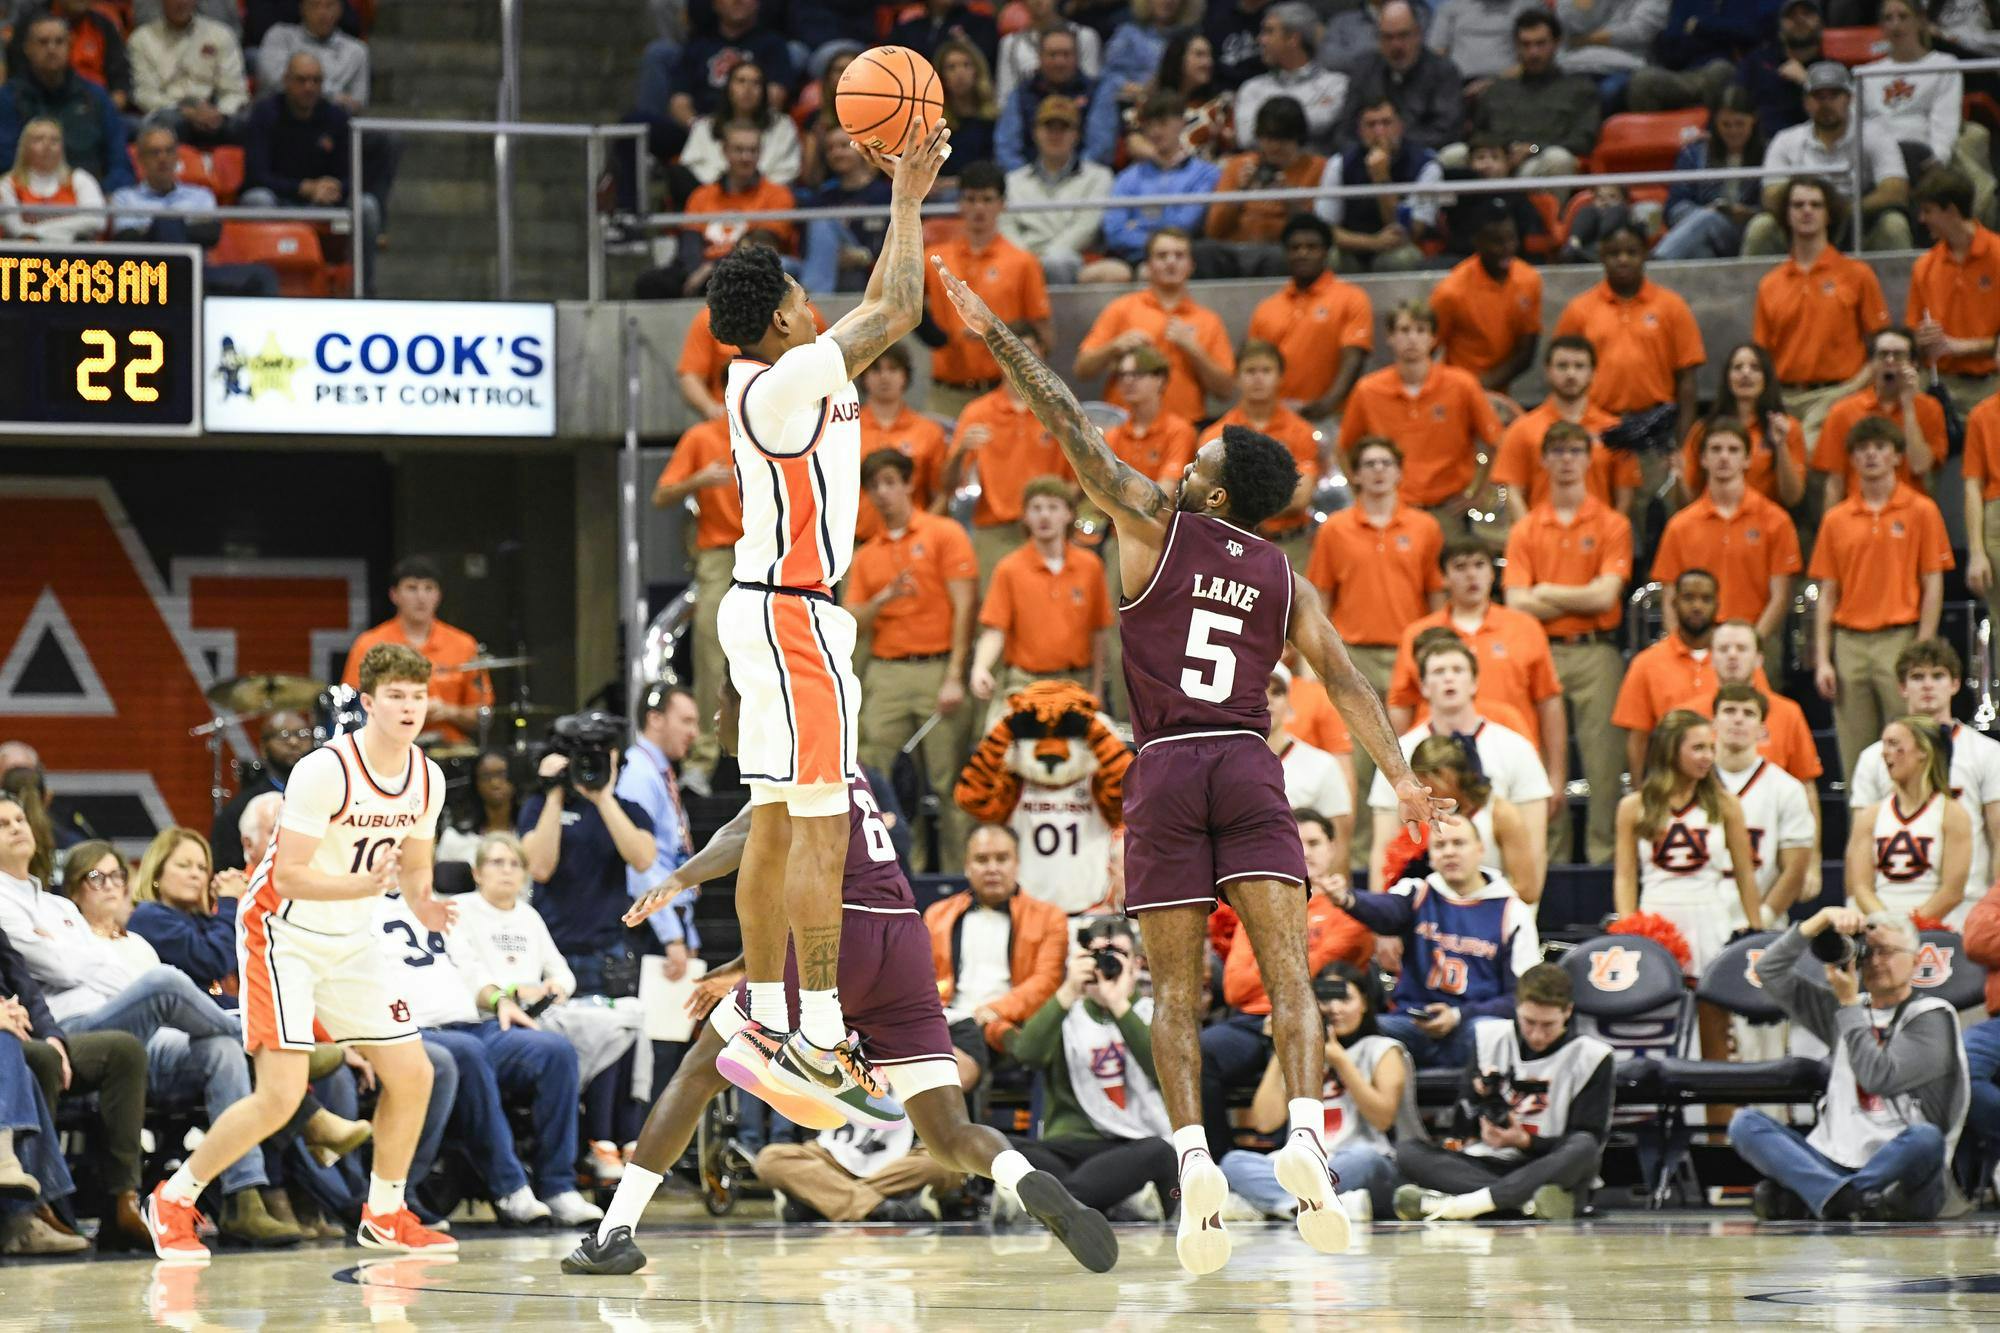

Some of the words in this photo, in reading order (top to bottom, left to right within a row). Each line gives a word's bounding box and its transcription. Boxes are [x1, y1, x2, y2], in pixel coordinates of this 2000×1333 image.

[76, 329, 164, 402] 22
[315, 332, 545, 378] COOK'S
[315, 384, 388, 403] PEST
[399, 385, 544, 408] CONTROL
[1191, 573, 1261, 613] LANE
[1179, 607, 1244, 704] 5
[852, 789, 897, 863] 6
[1033, 823, 1078, 856] 01
